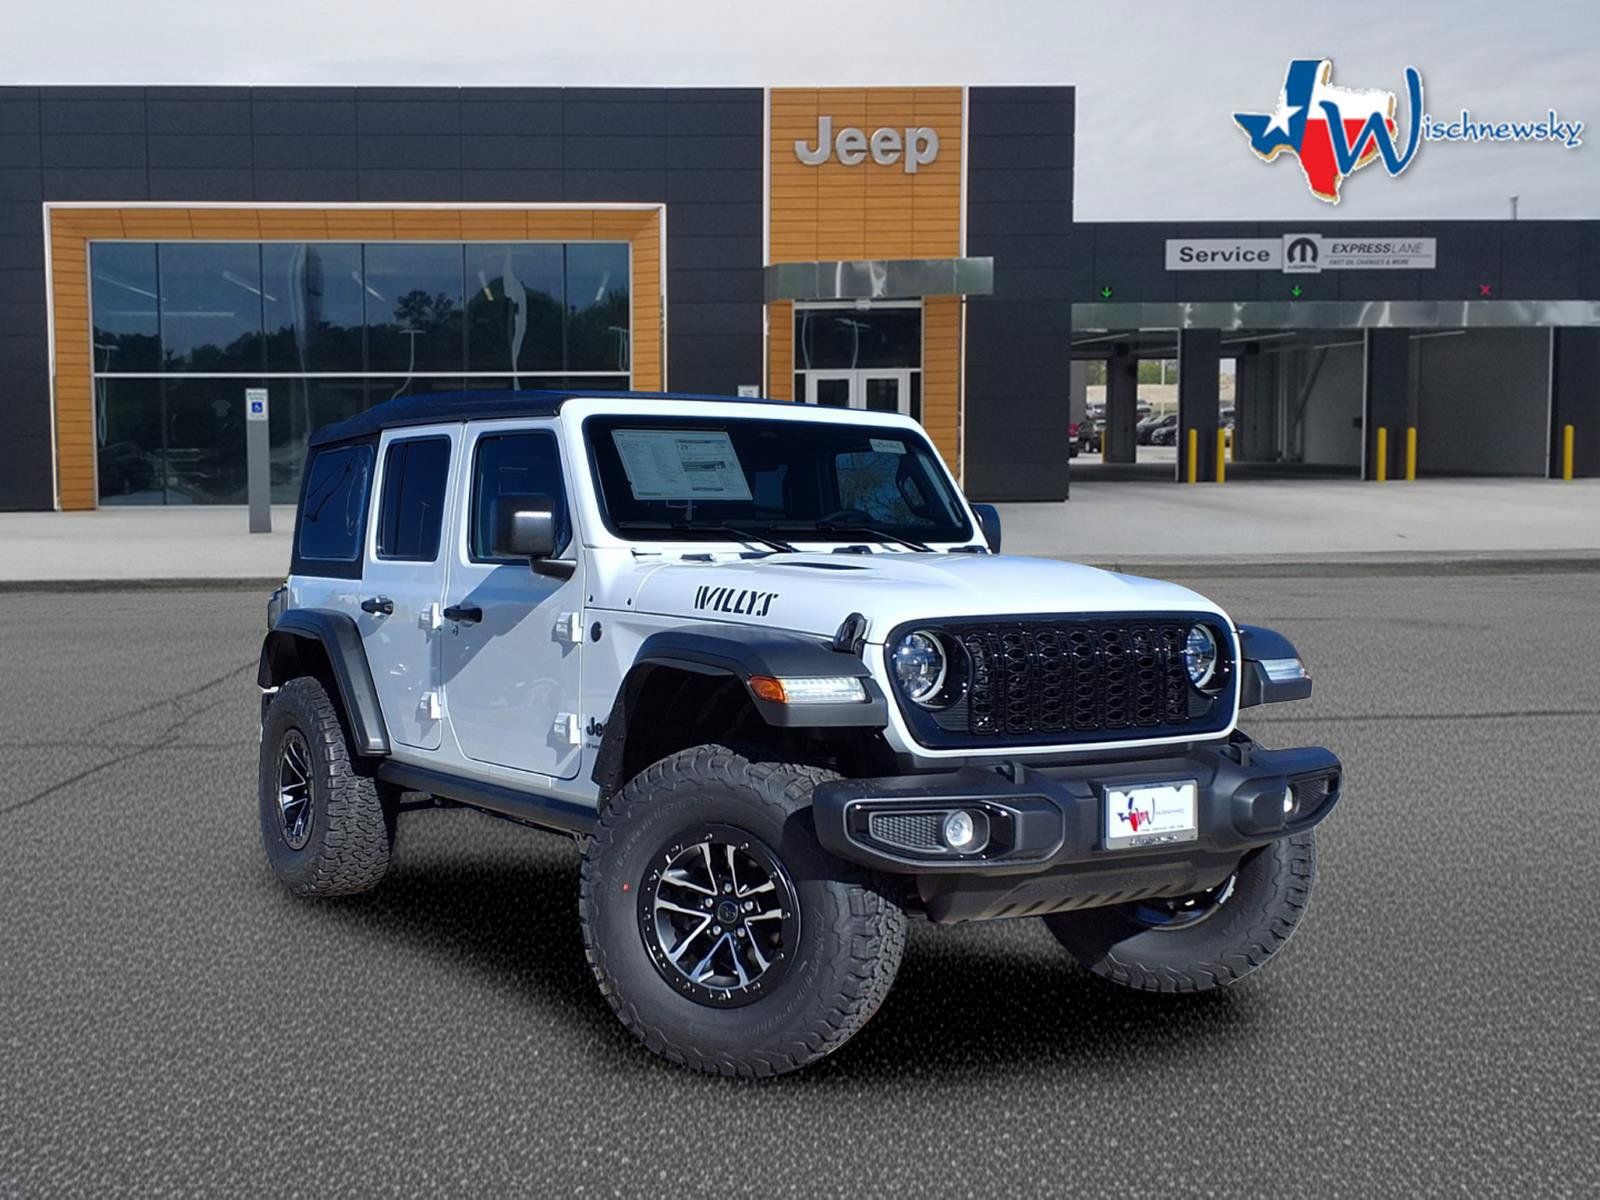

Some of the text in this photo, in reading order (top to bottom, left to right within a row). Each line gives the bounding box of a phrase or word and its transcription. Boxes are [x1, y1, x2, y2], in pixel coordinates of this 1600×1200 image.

[794, 116, 939, 174] Jeep
[1179, 246, 1270, 263] Service
[694, 585, 779, 617] WILLYS
